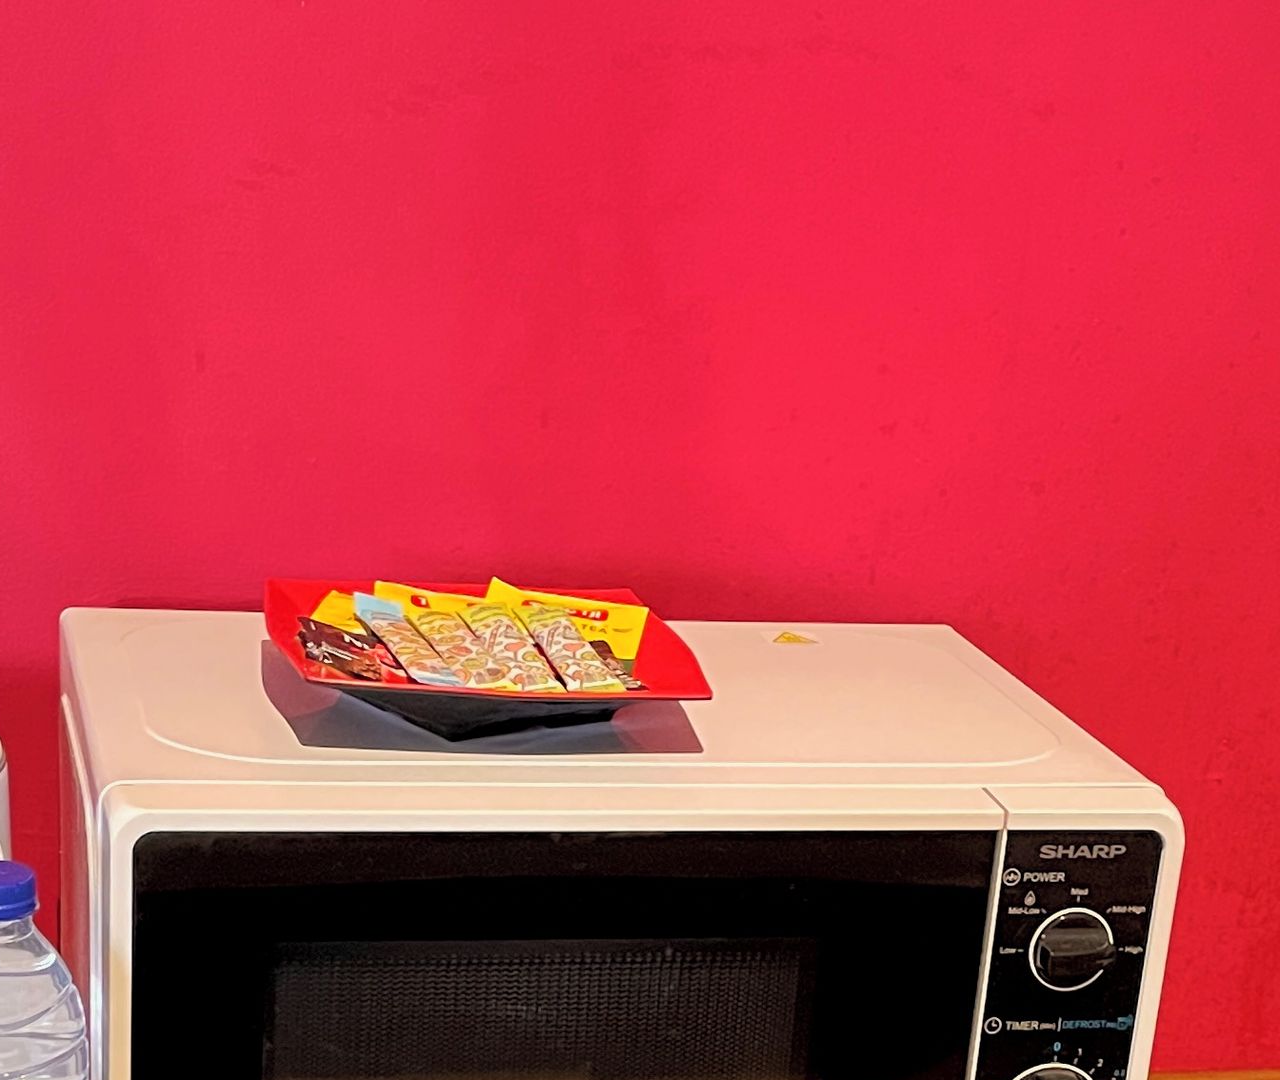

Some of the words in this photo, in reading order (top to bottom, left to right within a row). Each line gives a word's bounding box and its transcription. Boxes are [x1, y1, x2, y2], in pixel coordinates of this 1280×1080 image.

[581, 623, 608, 635] TEA
[1039, 844, 1127, 860] SHARP
[1023, 871, 1066, 884] POWER
[999, 946, 1017, 954] Low
[1006, 1020, 1039, 1031] TIMER
[1061, 1019, 1106, 1030] DEFROST
[1054, 1041, 1062, 1052] 0
[1077, 1048, 1083, 1056] 1
[1097, 1058, 1104, 1067] 2
